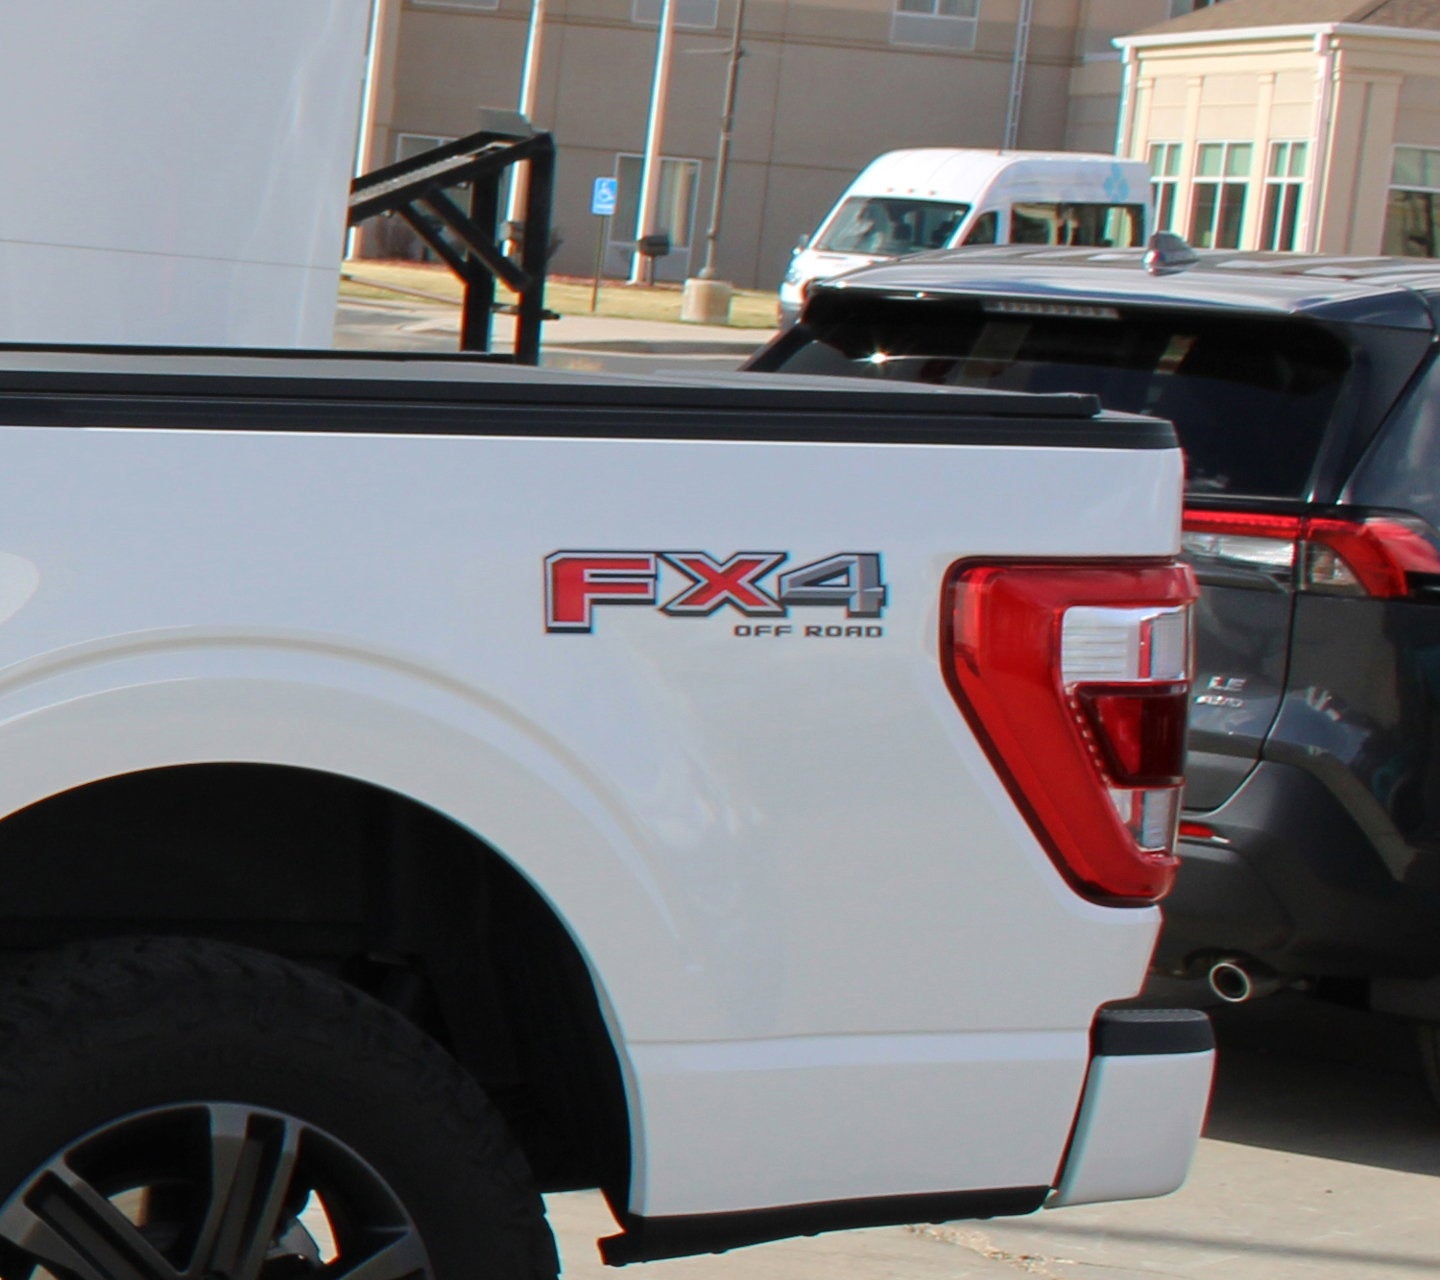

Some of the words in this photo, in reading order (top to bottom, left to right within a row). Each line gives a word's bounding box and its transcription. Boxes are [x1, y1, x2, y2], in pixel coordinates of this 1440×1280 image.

[544, 550, 887, 634] FX4
[733, 625, 792, 638] OFF
[804, 625, 883, 639] ROAD
